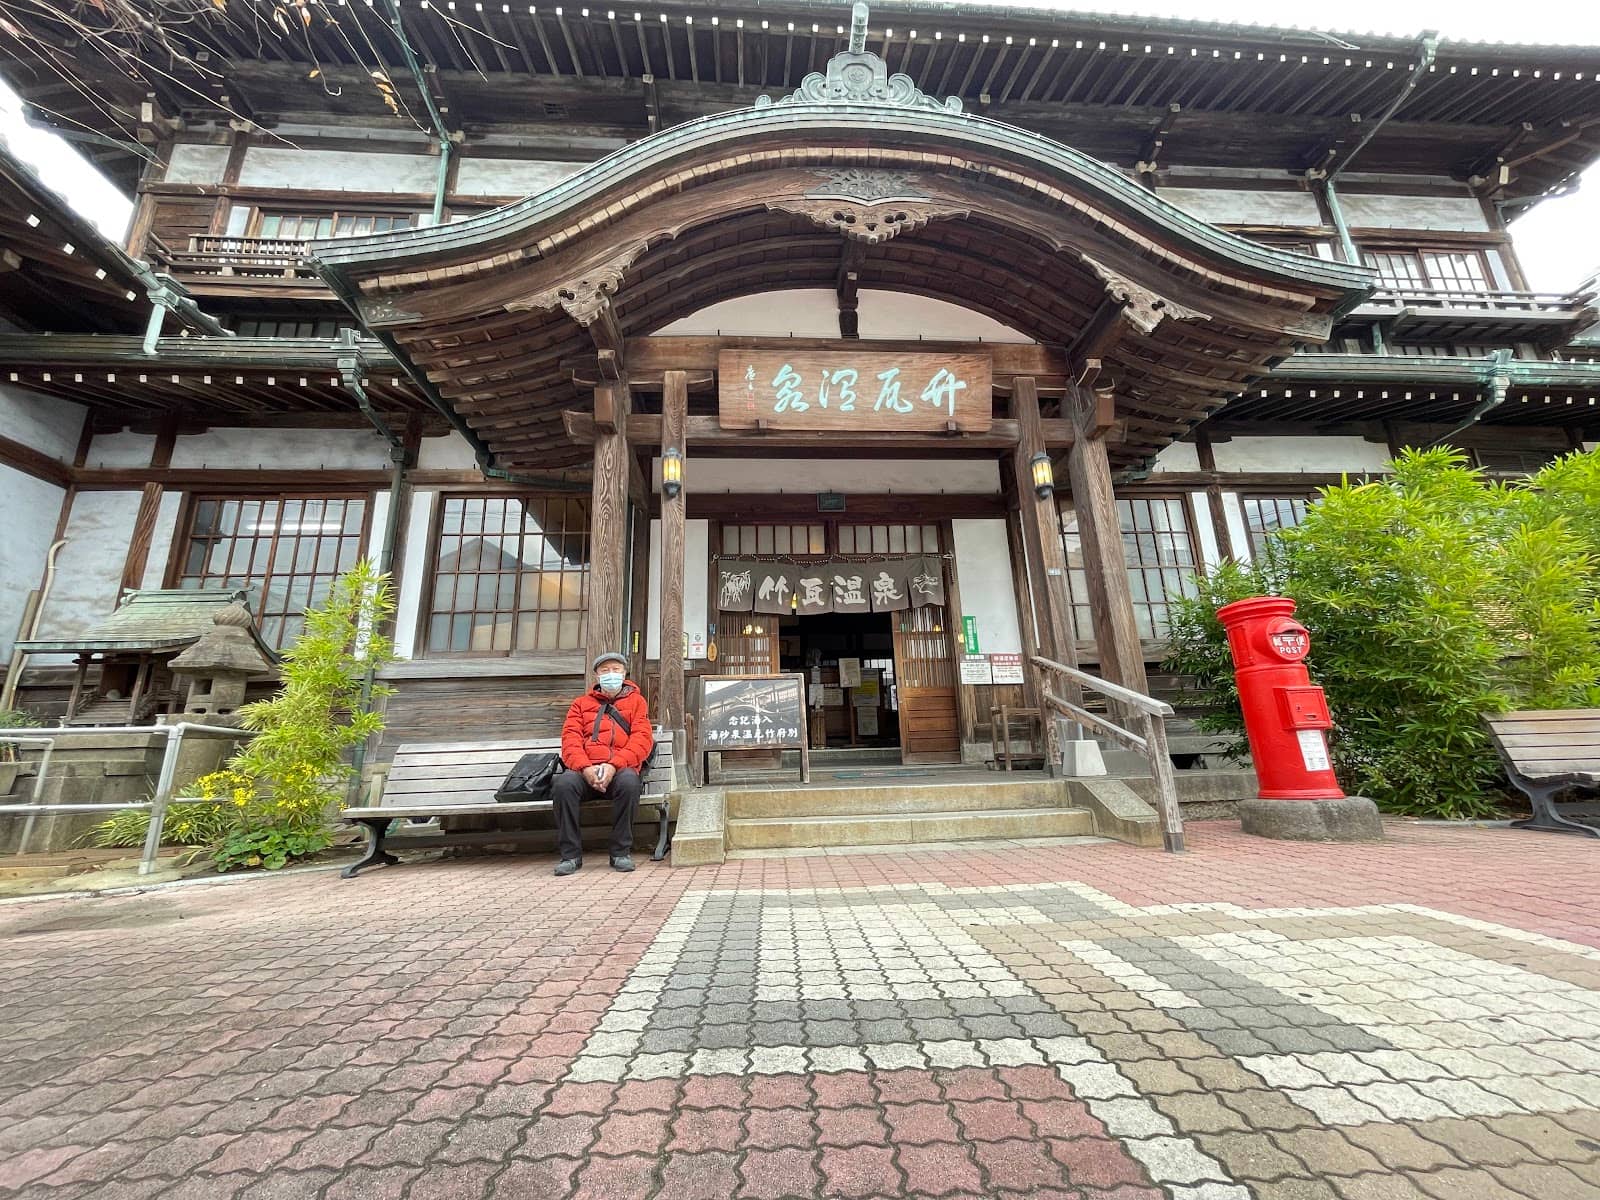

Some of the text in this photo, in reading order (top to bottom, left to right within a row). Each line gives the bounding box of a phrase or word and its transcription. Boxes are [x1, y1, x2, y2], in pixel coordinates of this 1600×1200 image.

[758, 571, 904, 606] 竹瓦温泉
[1279, 646, 1302, 654] POST
